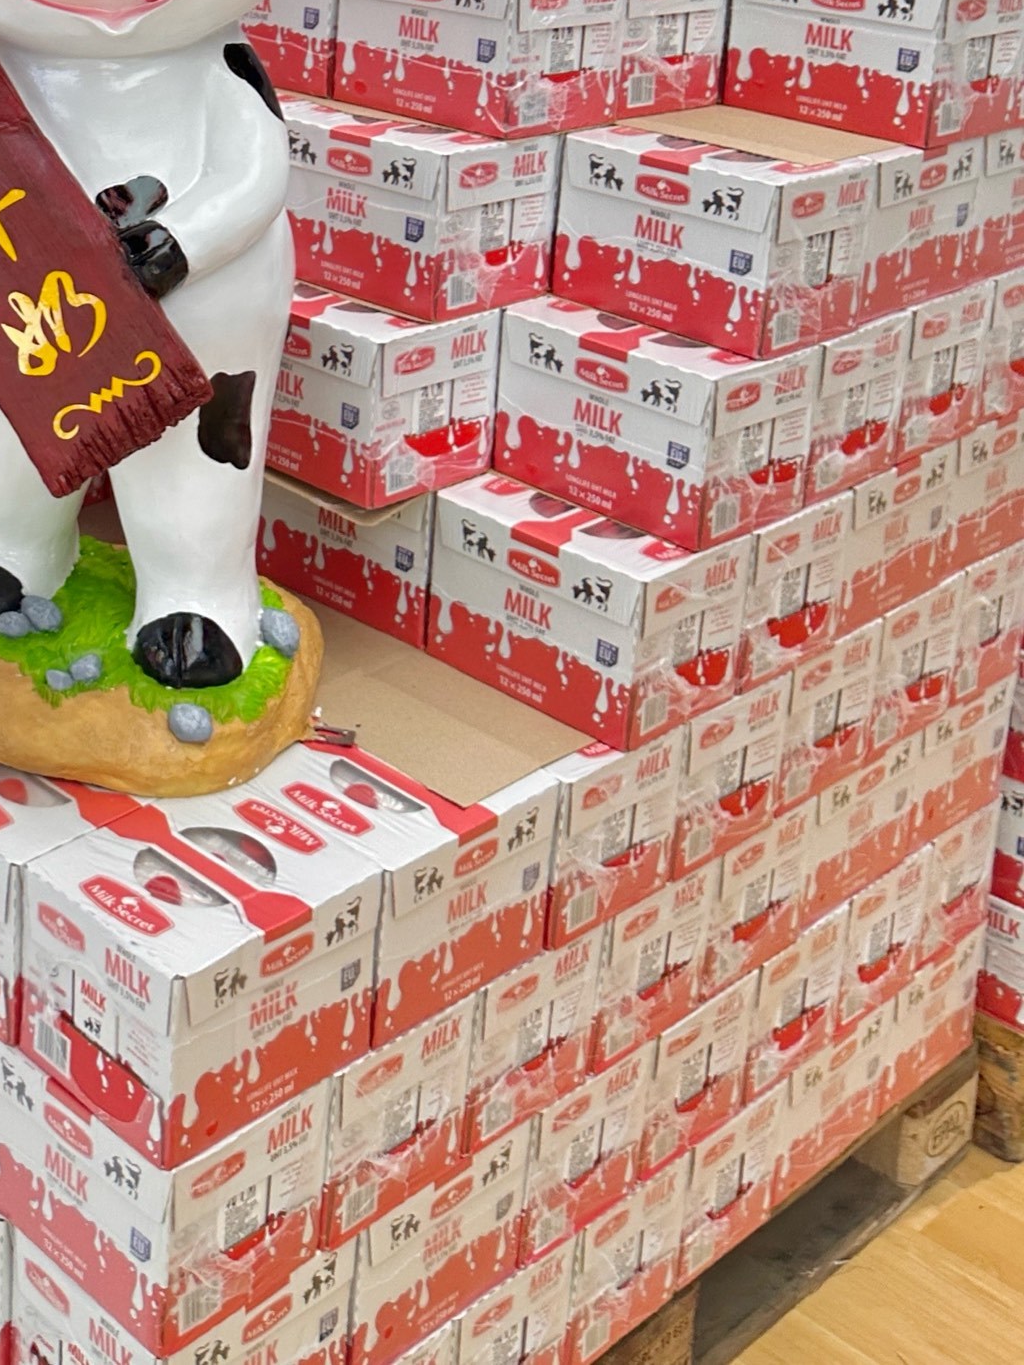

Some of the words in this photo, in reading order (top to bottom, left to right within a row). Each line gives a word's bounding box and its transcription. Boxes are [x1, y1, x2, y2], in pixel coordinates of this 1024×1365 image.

[398, 15, 440, 44] MILK
[804, 23, 854, 53] MILK
[513, 150, 548, 178] MILK
[325, 187, 368, 219] MILK
[640, 182, 659, 196] Milk
[659, 188, 686, 202] Secret
[837, 179, 869, 208] MILK
[634, 214, 685, 250] MILK
[451, 329, 488, 361] MILK
[578, 368, 597, 382] Milk
[598, 375, 625, 390] Secret
[775, 365, 808, 395] MILK
[572, 397, 623, 436] MILK
[511, 558, 529, 574] Milk
[530, 569, 556, 585] Secret
[705, 556, 739, 591] MILK
[503, 587, 553, 630] MILK
[288, 789, 317, 809] Milk
[315, 806, 358, 833] Secret
[88, 883, 117, 909] Milk
[113, 904, 156, 933] Secret
[447, 878, 488, 924] MILK
[105, 946, 151, 1004] MILK
[81, 978, 107, 1013] MILK
[249, 981, 298, 1031] MILK
[421, 1014, 461, 1059] MILK
[267, 1104, 313, 1156] MILK
[44, 1142, 89, 1205] MILK
